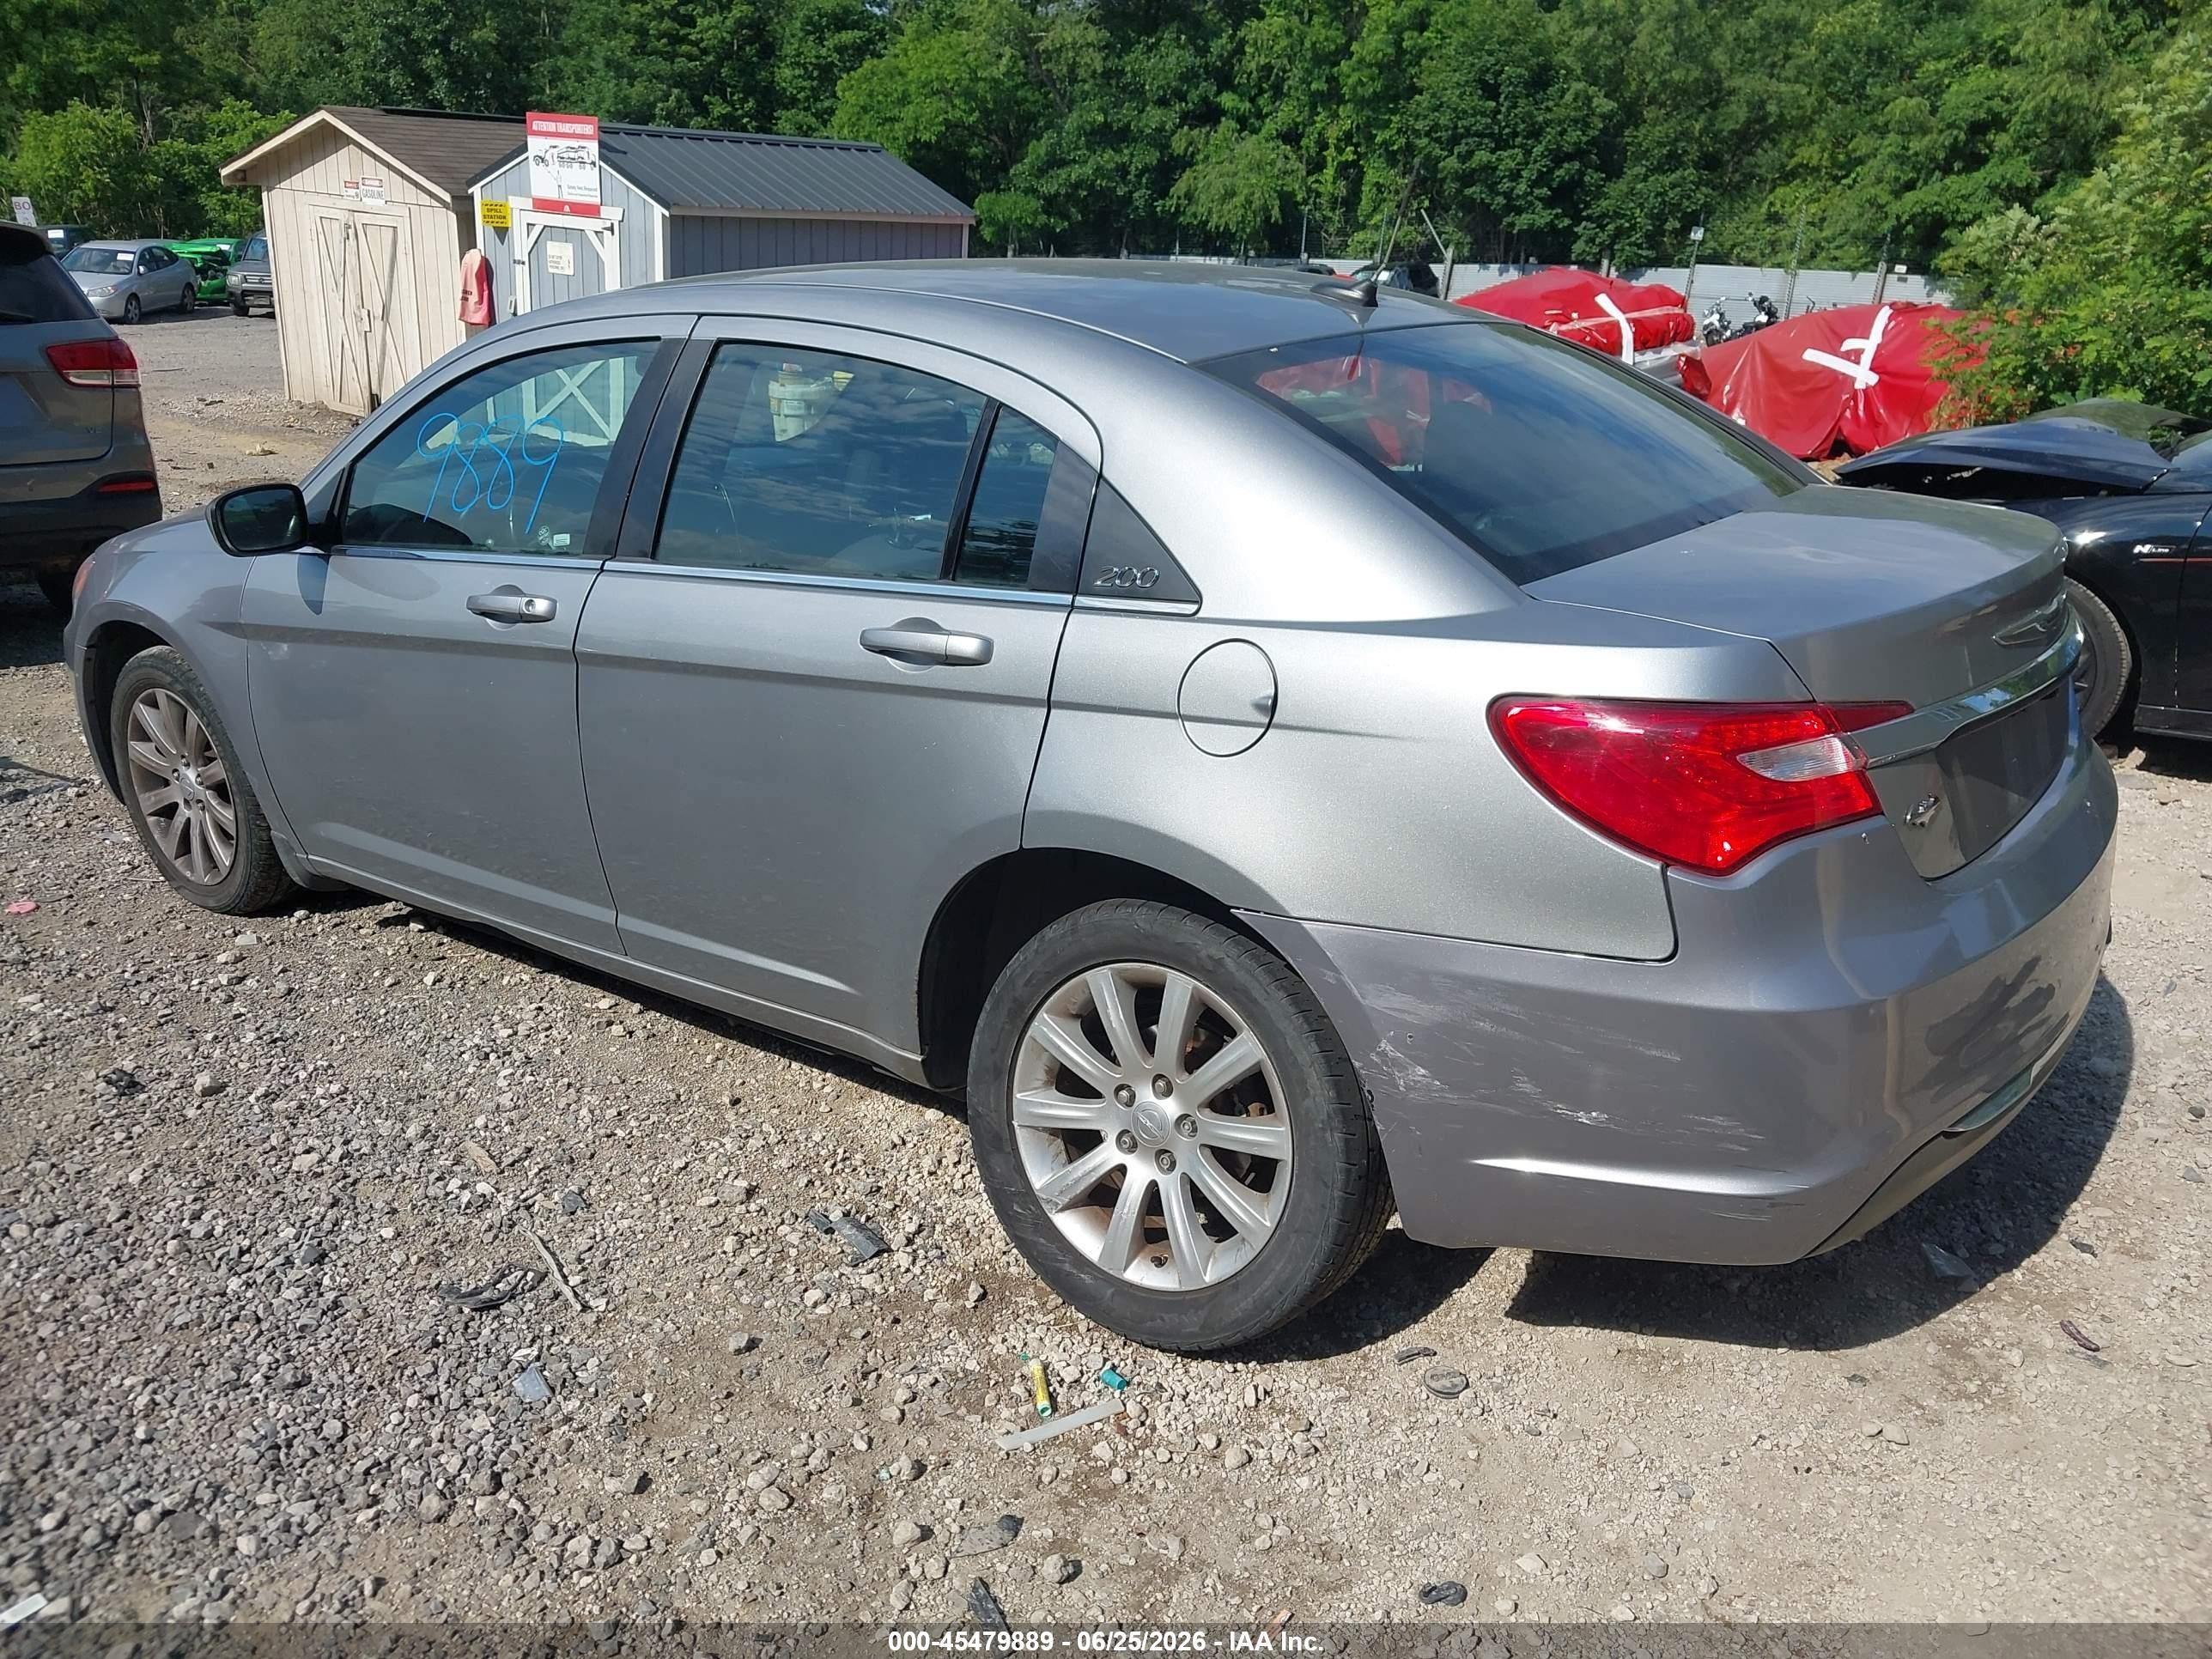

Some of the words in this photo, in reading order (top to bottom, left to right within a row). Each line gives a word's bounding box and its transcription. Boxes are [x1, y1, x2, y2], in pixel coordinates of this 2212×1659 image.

[362, 188, 385, 200] GASOLINE
[416, 412, 563, 534] 9889
[1092, 565, 1160, 588] 200
